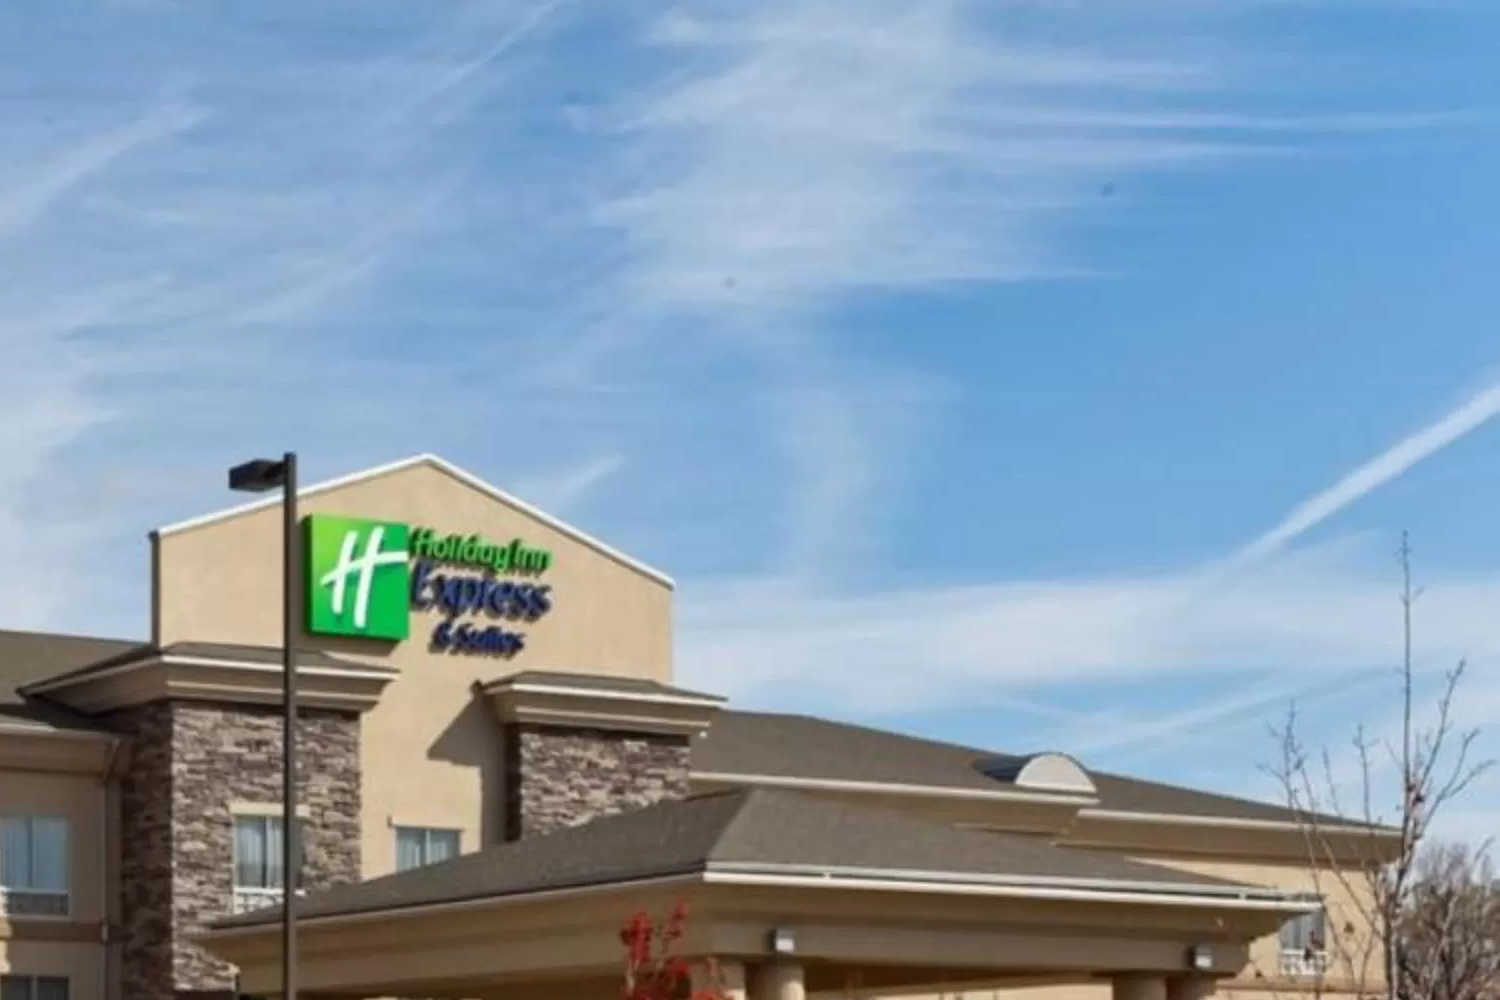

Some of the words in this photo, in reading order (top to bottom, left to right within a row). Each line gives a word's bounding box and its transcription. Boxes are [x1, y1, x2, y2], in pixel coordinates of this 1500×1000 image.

[410, 527, 506, 572] Holiday
[506, 538, 551, 573] Inn
[410, 557, 552, 620] Express
